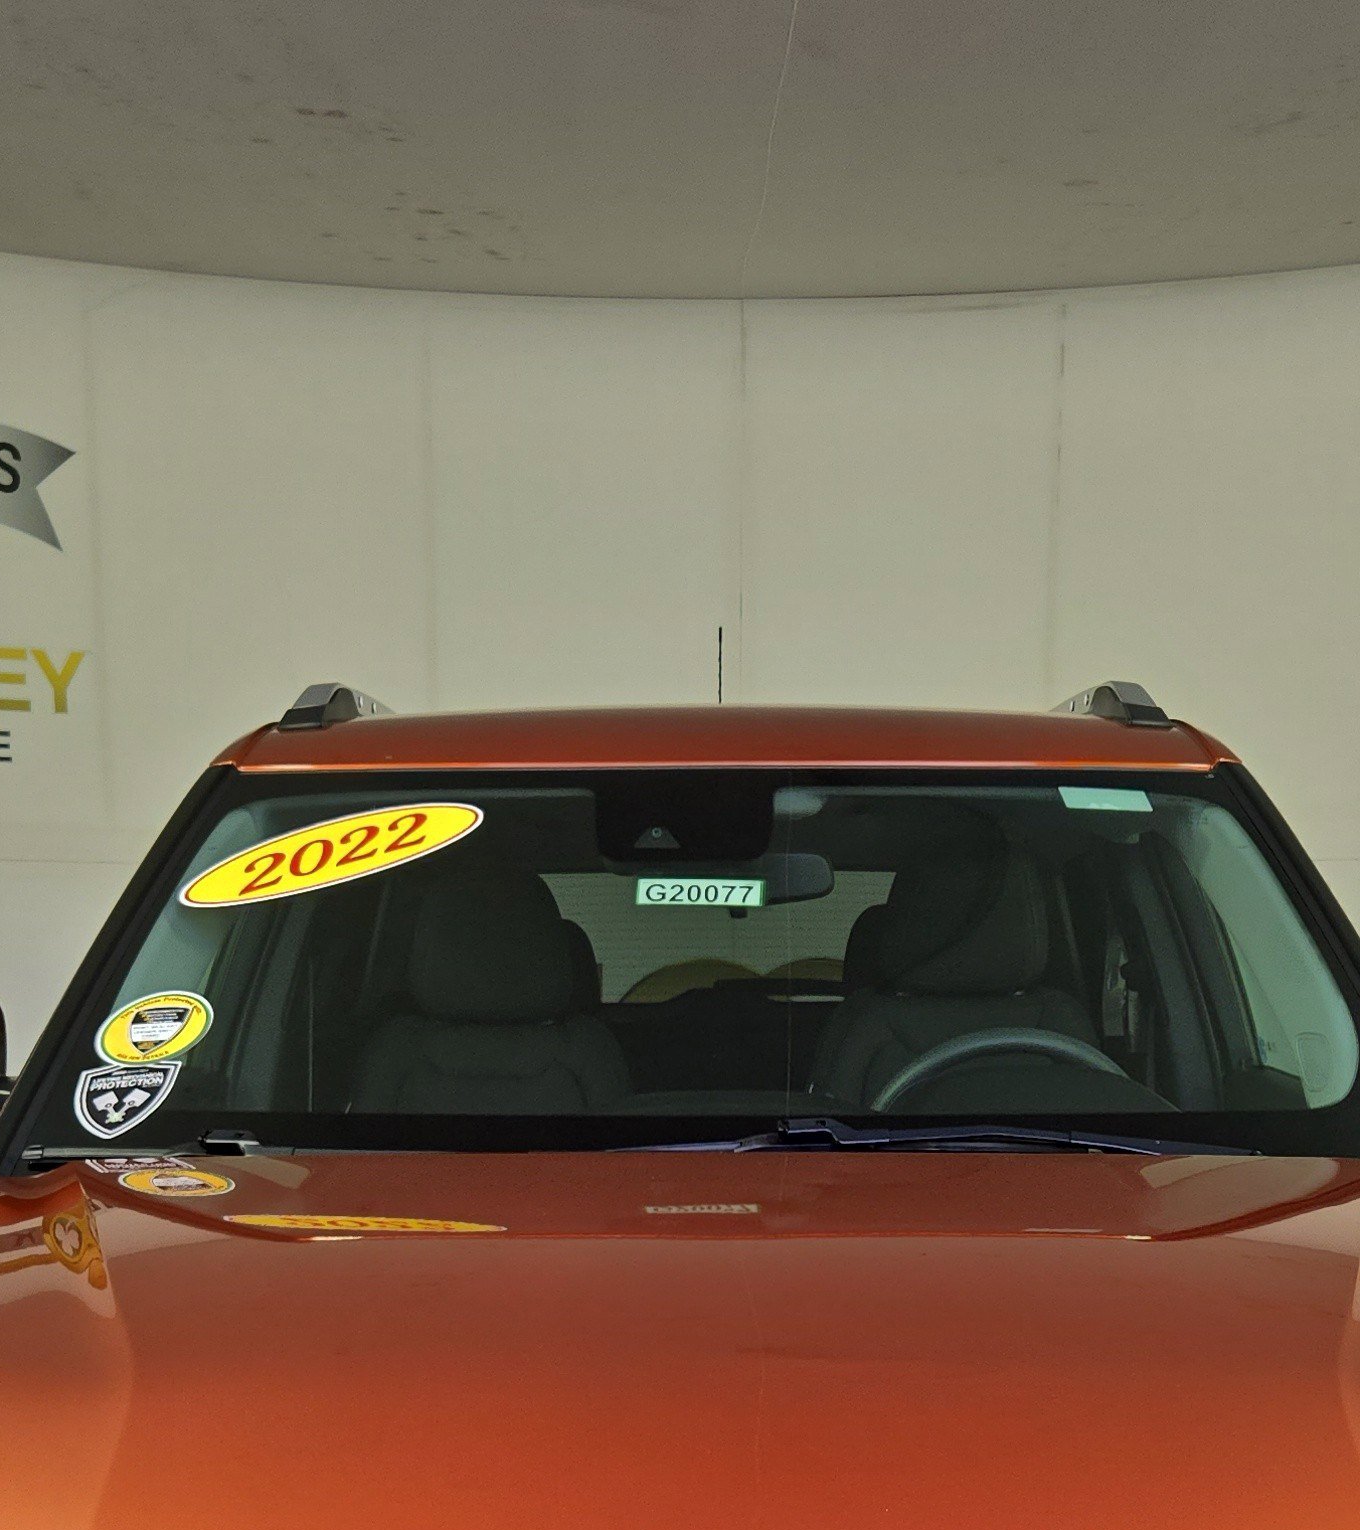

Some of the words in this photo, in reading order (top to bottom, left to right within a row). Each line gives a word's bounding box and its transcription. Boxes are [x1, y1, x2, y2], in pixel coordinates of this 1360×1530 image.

[238, 813, 427, 896] 2022
[645, 883, 754, 903] G20077
[90, 1077, 164, 1091] PROTECTION
